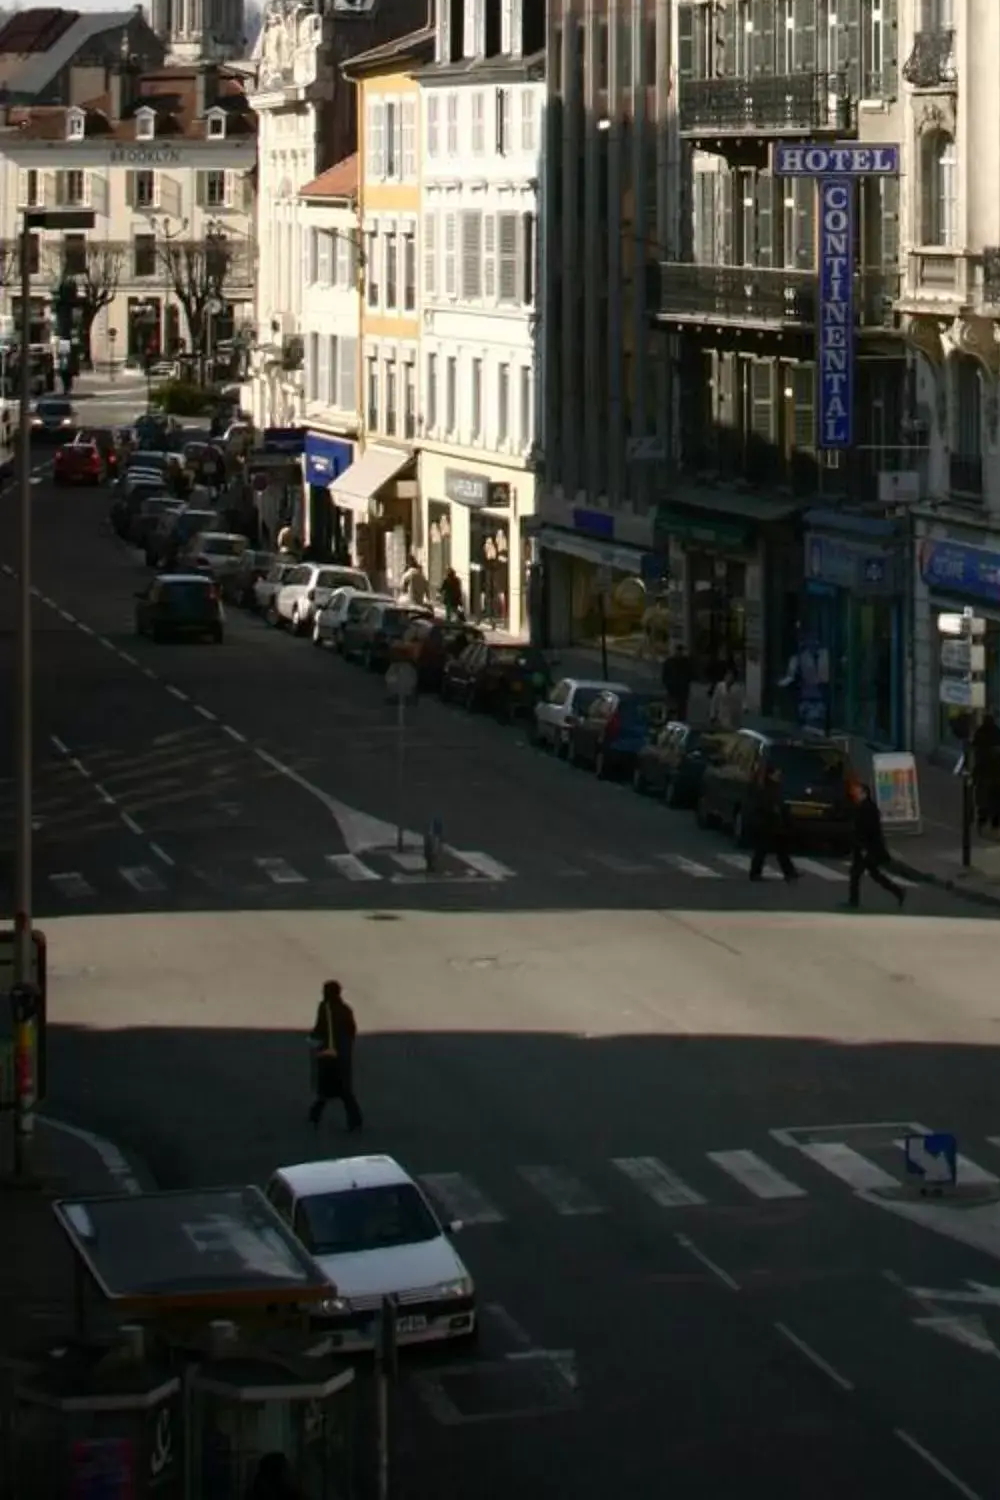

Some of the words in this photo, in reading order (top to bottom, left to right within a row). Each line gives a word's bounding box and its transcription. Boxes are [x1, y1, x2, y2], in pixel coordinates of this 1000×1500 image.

[110, 149, 180, 162] BROOKLYN
[781, 149, 893, 172] HOTEL
[824, 187, 848, 441] CONTINENTAL
